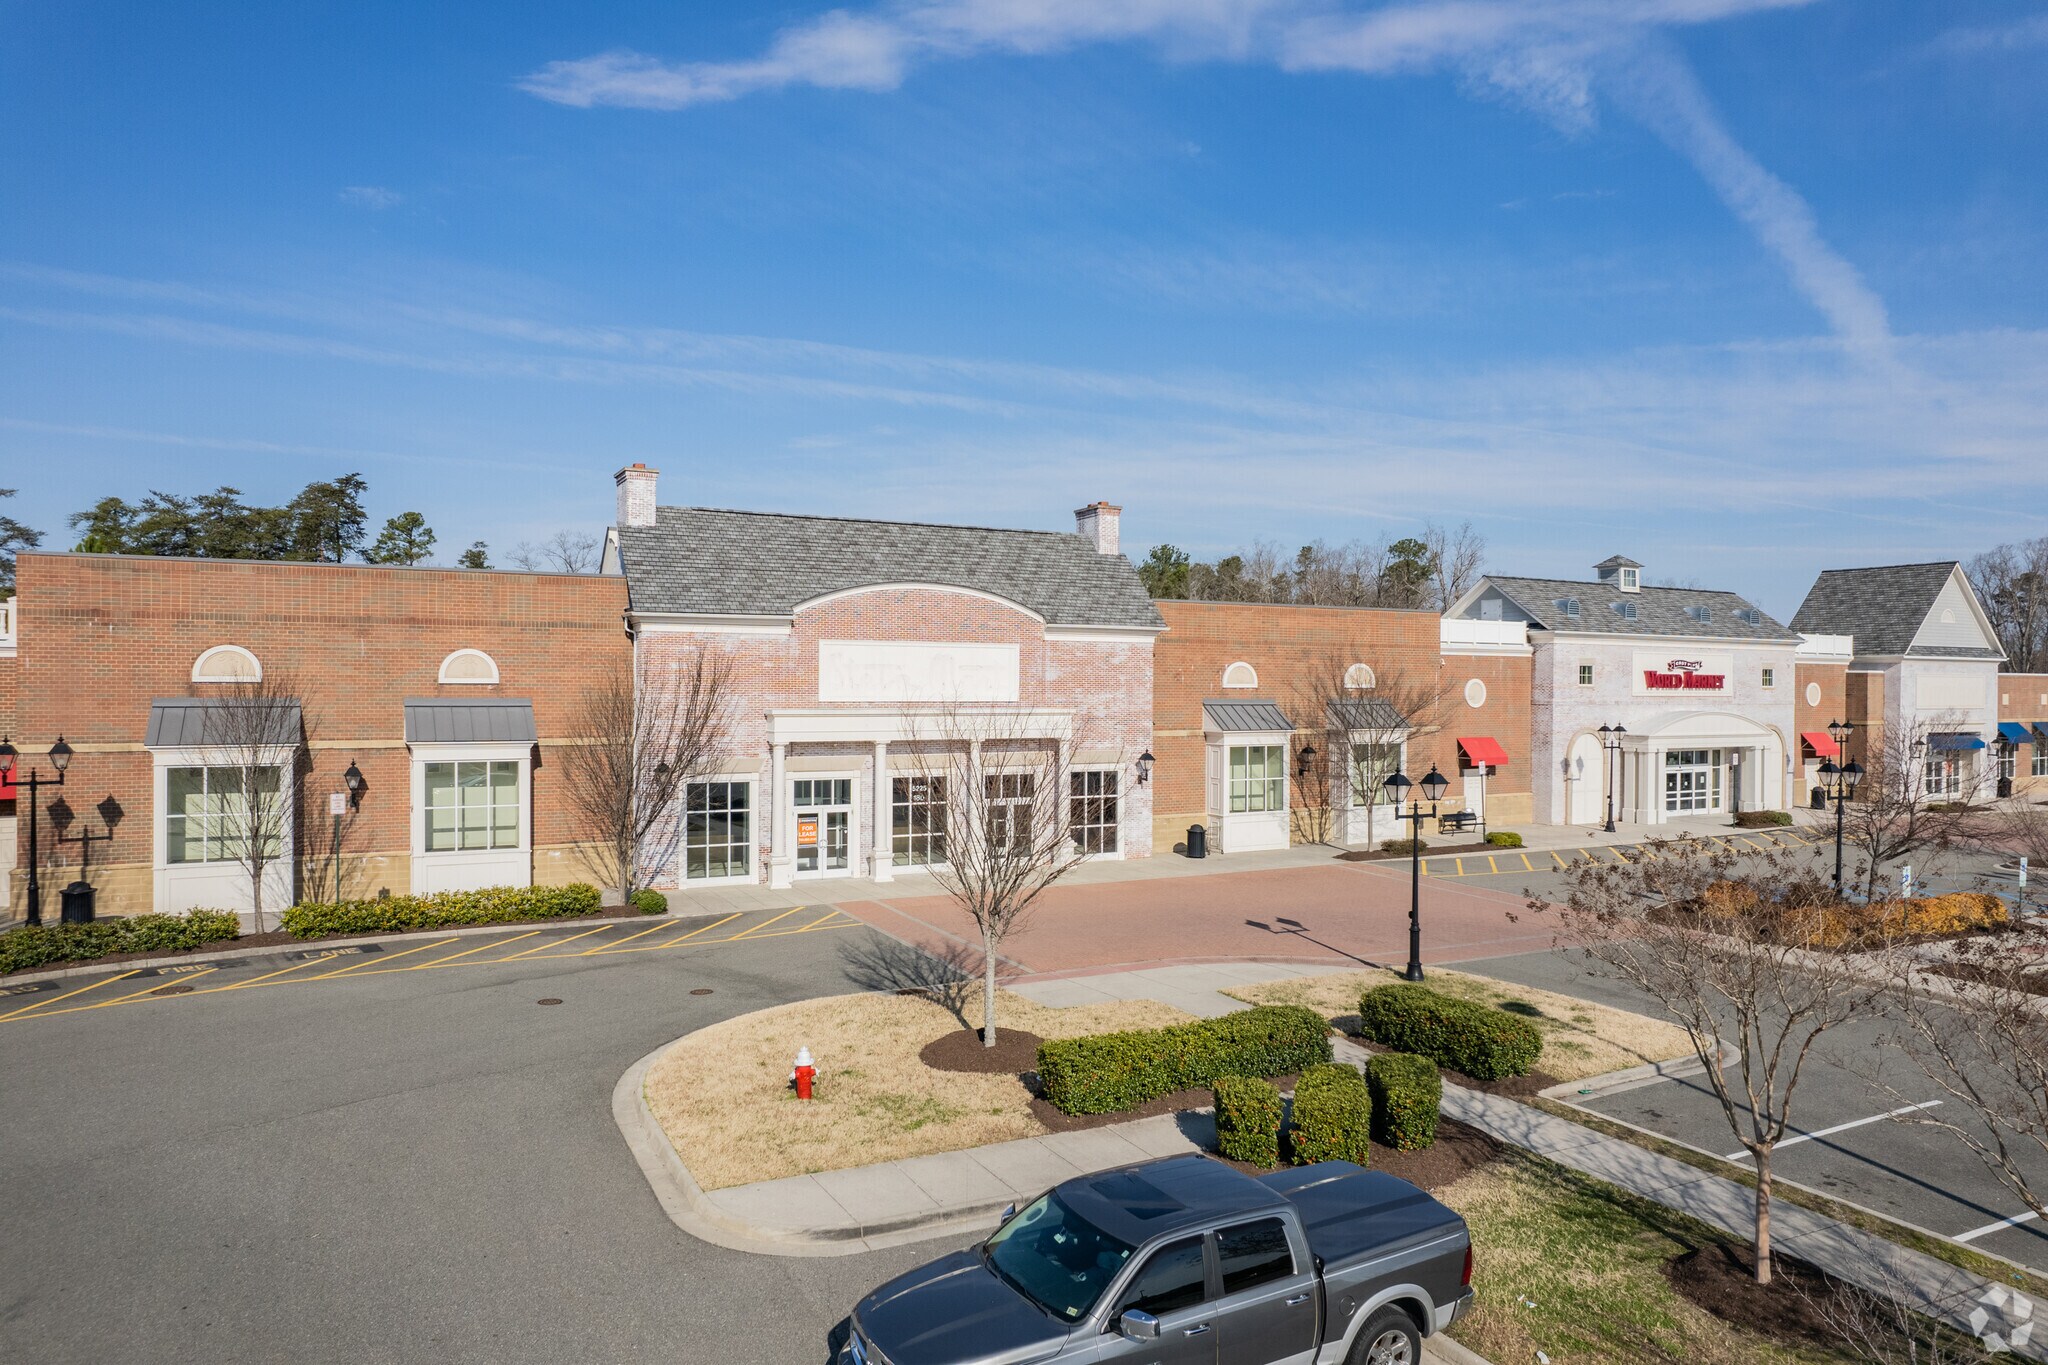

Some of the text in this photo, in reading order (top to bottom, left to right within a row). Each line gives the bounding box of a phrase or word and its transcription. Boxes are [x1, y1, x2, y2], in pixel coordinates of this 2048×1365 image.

[1643, 670, 1725, 689] WORLD MARKET
[157, 964, 212, 974] FIRE
[302, 947, 361, 958] LANE
